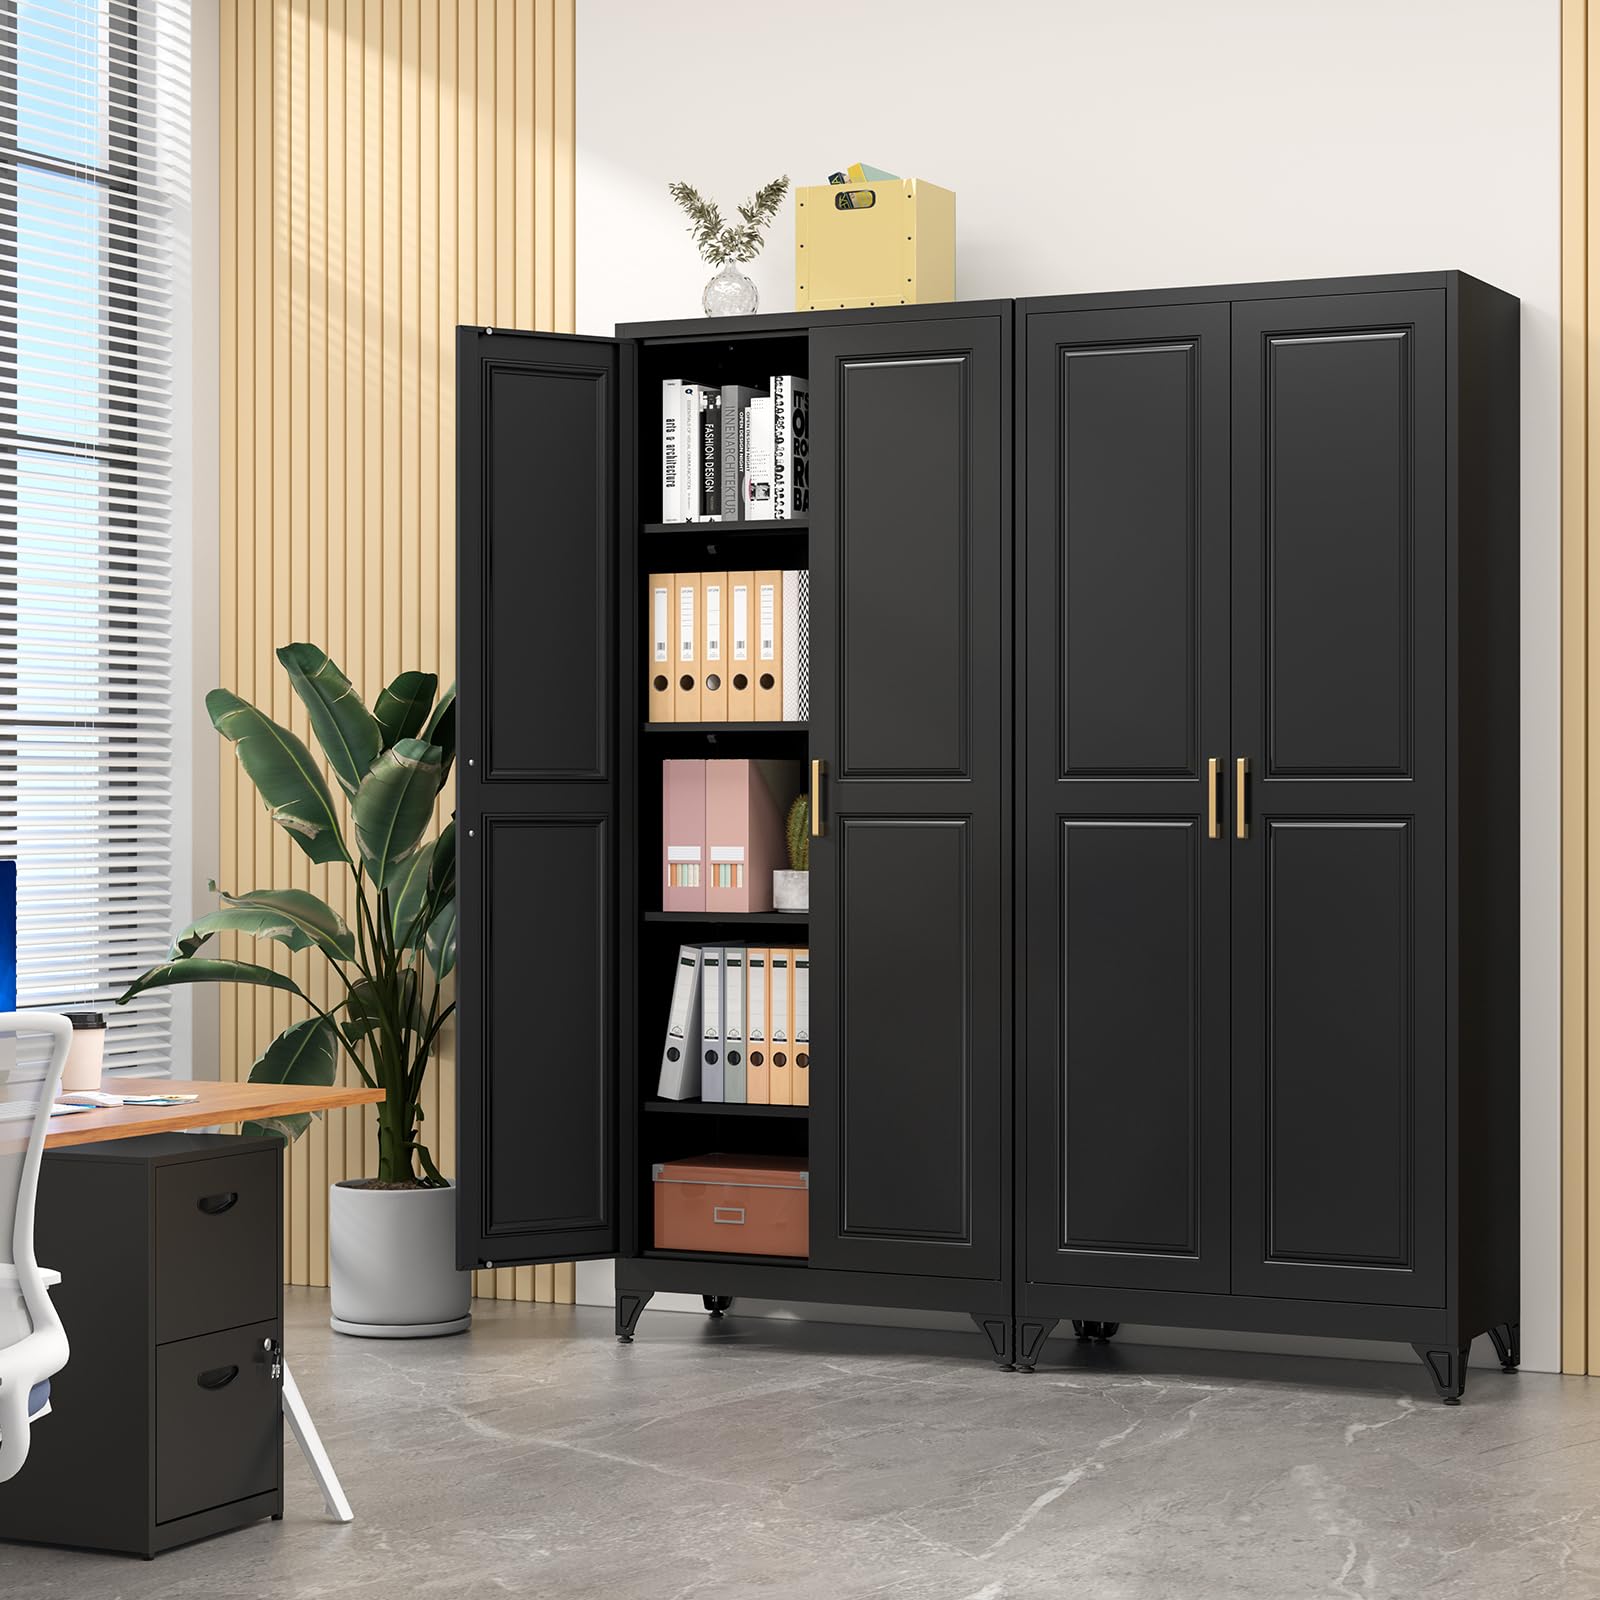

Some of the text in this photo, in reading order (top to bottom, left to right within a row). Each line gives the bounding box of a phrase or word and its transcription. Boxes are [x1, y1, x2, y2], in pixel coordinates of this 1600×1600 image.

[665, 418, 676, 433] arts
[704, 423, 715, 460] FASHION
[665, 444, 677, 488] architecture
[704, 462, 715, 493] DESIGN
[724, 406, 736, 515] INNENARCHITEKTUR
